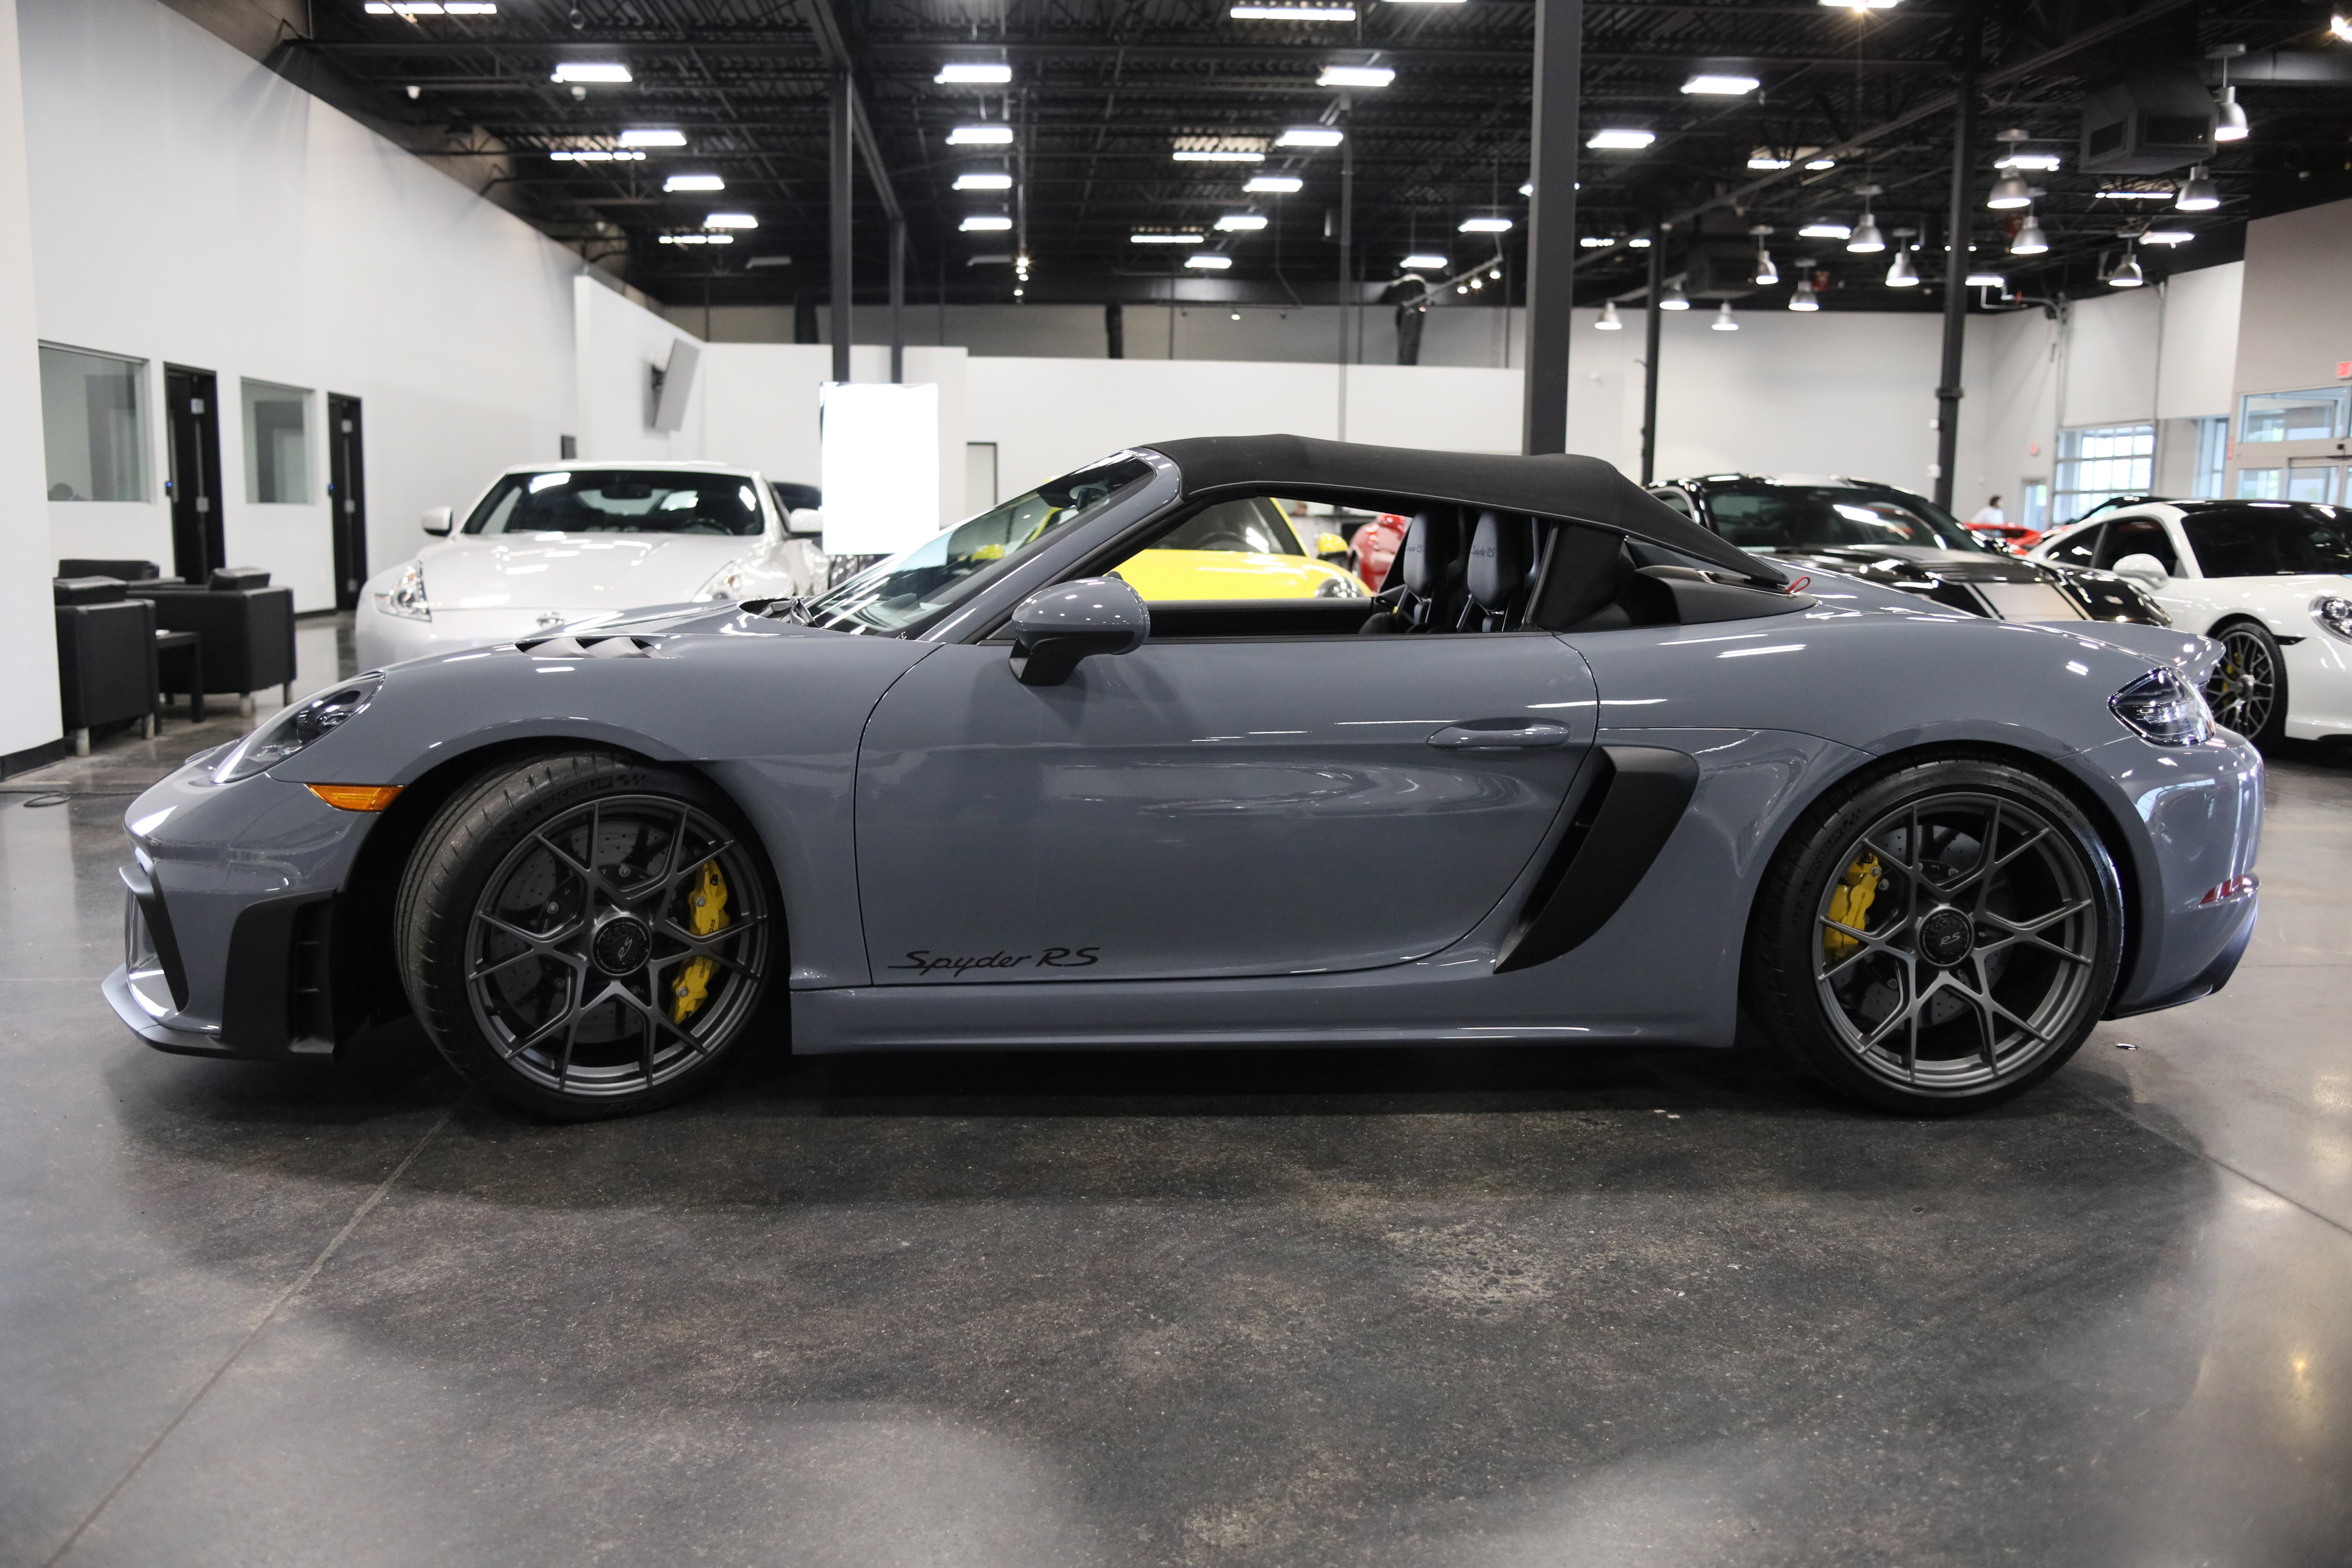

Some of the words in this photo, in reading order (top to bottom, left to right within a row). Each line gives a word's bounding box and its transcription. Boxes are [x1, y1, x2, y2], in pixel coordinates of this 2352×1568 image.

[541, 776, 612, 811] MICHELIN
[617, 936, 633, 962] RS
[1940, 931, 1960, 947] RS
[888, 951, 1032, 978] Spyder
[1036, 947, 1100, 967] RS
